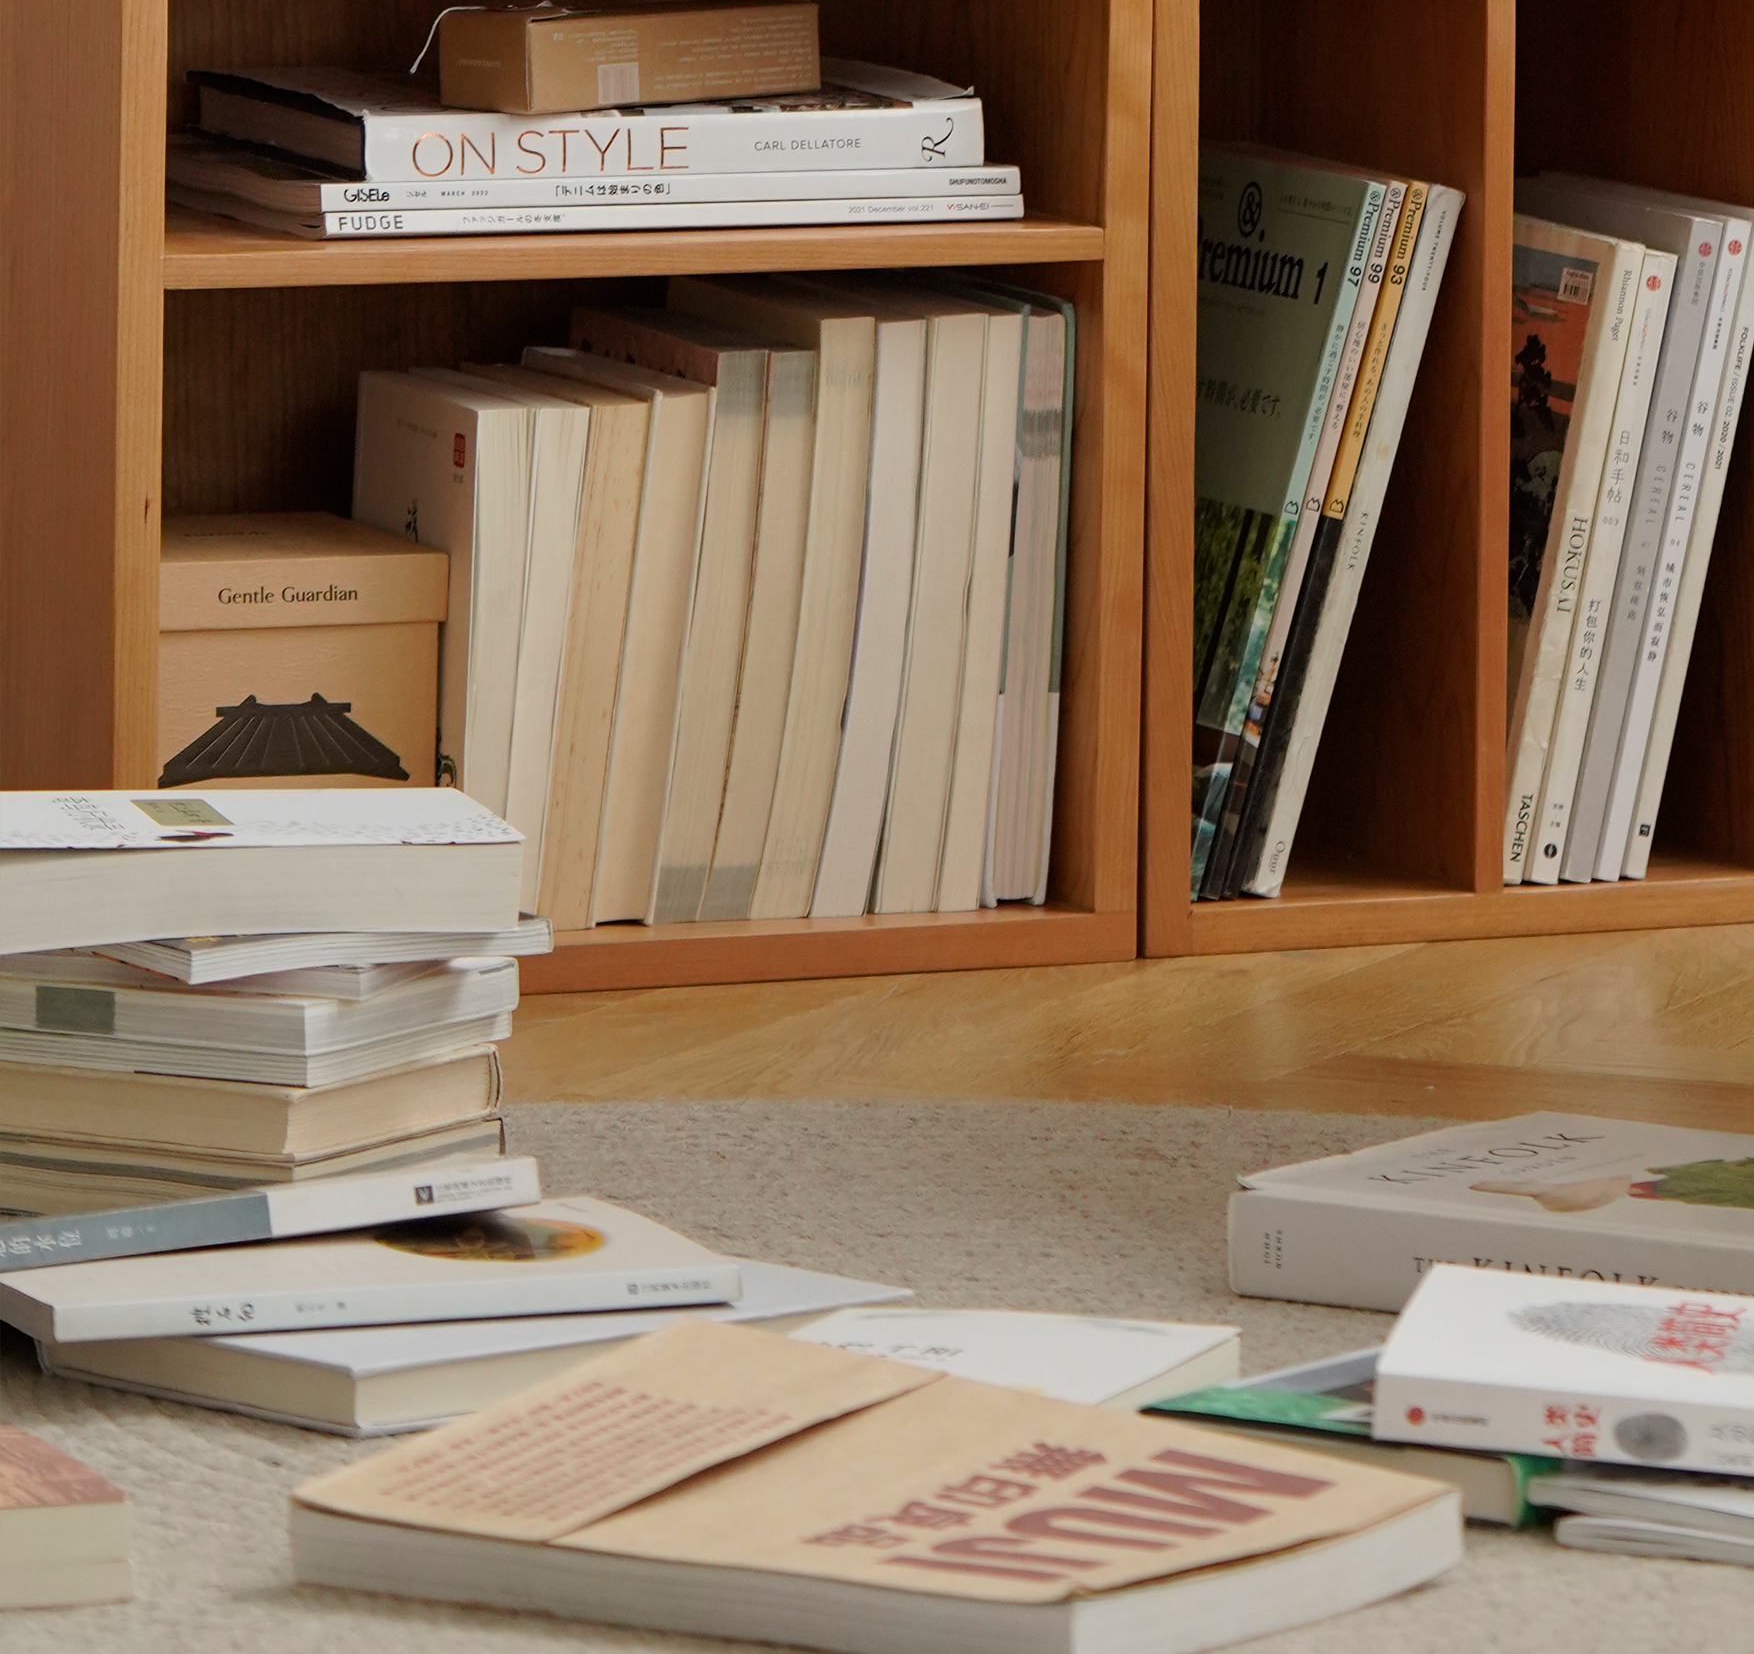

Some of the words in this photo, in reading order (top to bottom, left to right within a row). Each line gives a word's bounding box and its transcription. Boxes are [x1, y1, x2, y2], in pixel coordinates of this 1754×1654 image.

[411, 131, 496, 178] ON
[515, 126, 690, 175] STYLE
[754, 139, 786, 152] CARL
[790, 137, 862, 151] DELLATORE
[338, 214, 404, 231] FUDGE
[848, 205, 866, 214] 2021
[868, 204, 905, 214] December
[441, 189, 466, 197] MARCH
[1197, 236, 1306, 303] remium
[1347, 264, 1363, 288] 97
[1367, 262, 1383, 285] 99
[1390, 263, 1406, 286] 93
[1615, 269, 1634, 313] Rhiannon
[1733, 325, 1750, 371] FOLKLIFE
[1726, 377, 1740, 404] ISSUE
[1605, 430, 1631, 504] 日和手帖
[1713, 449, 1725, 471] 2021
[1645, 464, 1667, 525] CEREAL
[1675, 462, 1696, 523] CEREAL
[1345, 511, 1369, 573] KINFOLK
[1602, 515, 1620, 527] 003
[1556, 516, 1589, 614] HOKUSAI
[217, 585, 275, 605] Gentle
[281, 583, 359, 604] Guardian
[1574, 598, 1602, 692] 打包你的人生
[1509, 793, 1535, 863] TASCHEN
[1368, 1132, 1605, 1185] KINFOLK
[879, 1447, 1335, 1585] MUJI
